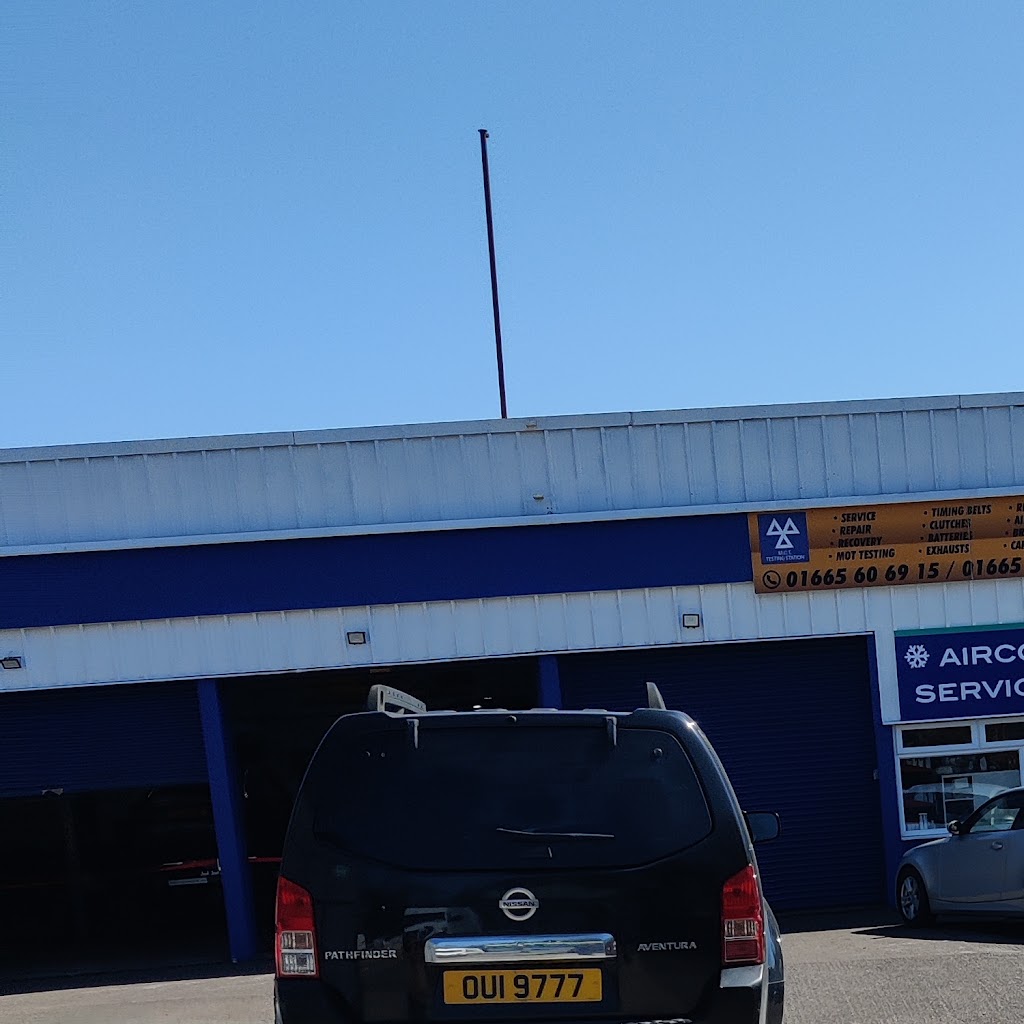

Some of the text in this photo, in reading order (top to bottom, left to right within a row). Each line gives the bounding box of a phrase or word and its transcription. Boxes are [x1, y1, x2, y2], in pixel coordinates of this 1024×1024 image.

[931, 504, 992, 517] TIMING BELTS
[841, 511, 876, 523] SERVICE
[840, 524, 871, 535] REPAIR
[838, 536, 883, 548] RECOVERY
[836, 548, 895, 561] MOT TESTING
[926, 543, 970, 555] EXHAUSTS
[786, 567, 847, 588] 01665
[854, 565, 878, 583] 60
[885, 563, 909, 582] 69
[918, 562, 940, 580] 15
[946, 561, 955, 579] /
[962, 556, 1021, 576] 01665
[637, 941, 697, 952] AVENTURA
[324, 949, 397, 960] PATHFINDER
[462, 974, 584, 1000] OUI 9777
